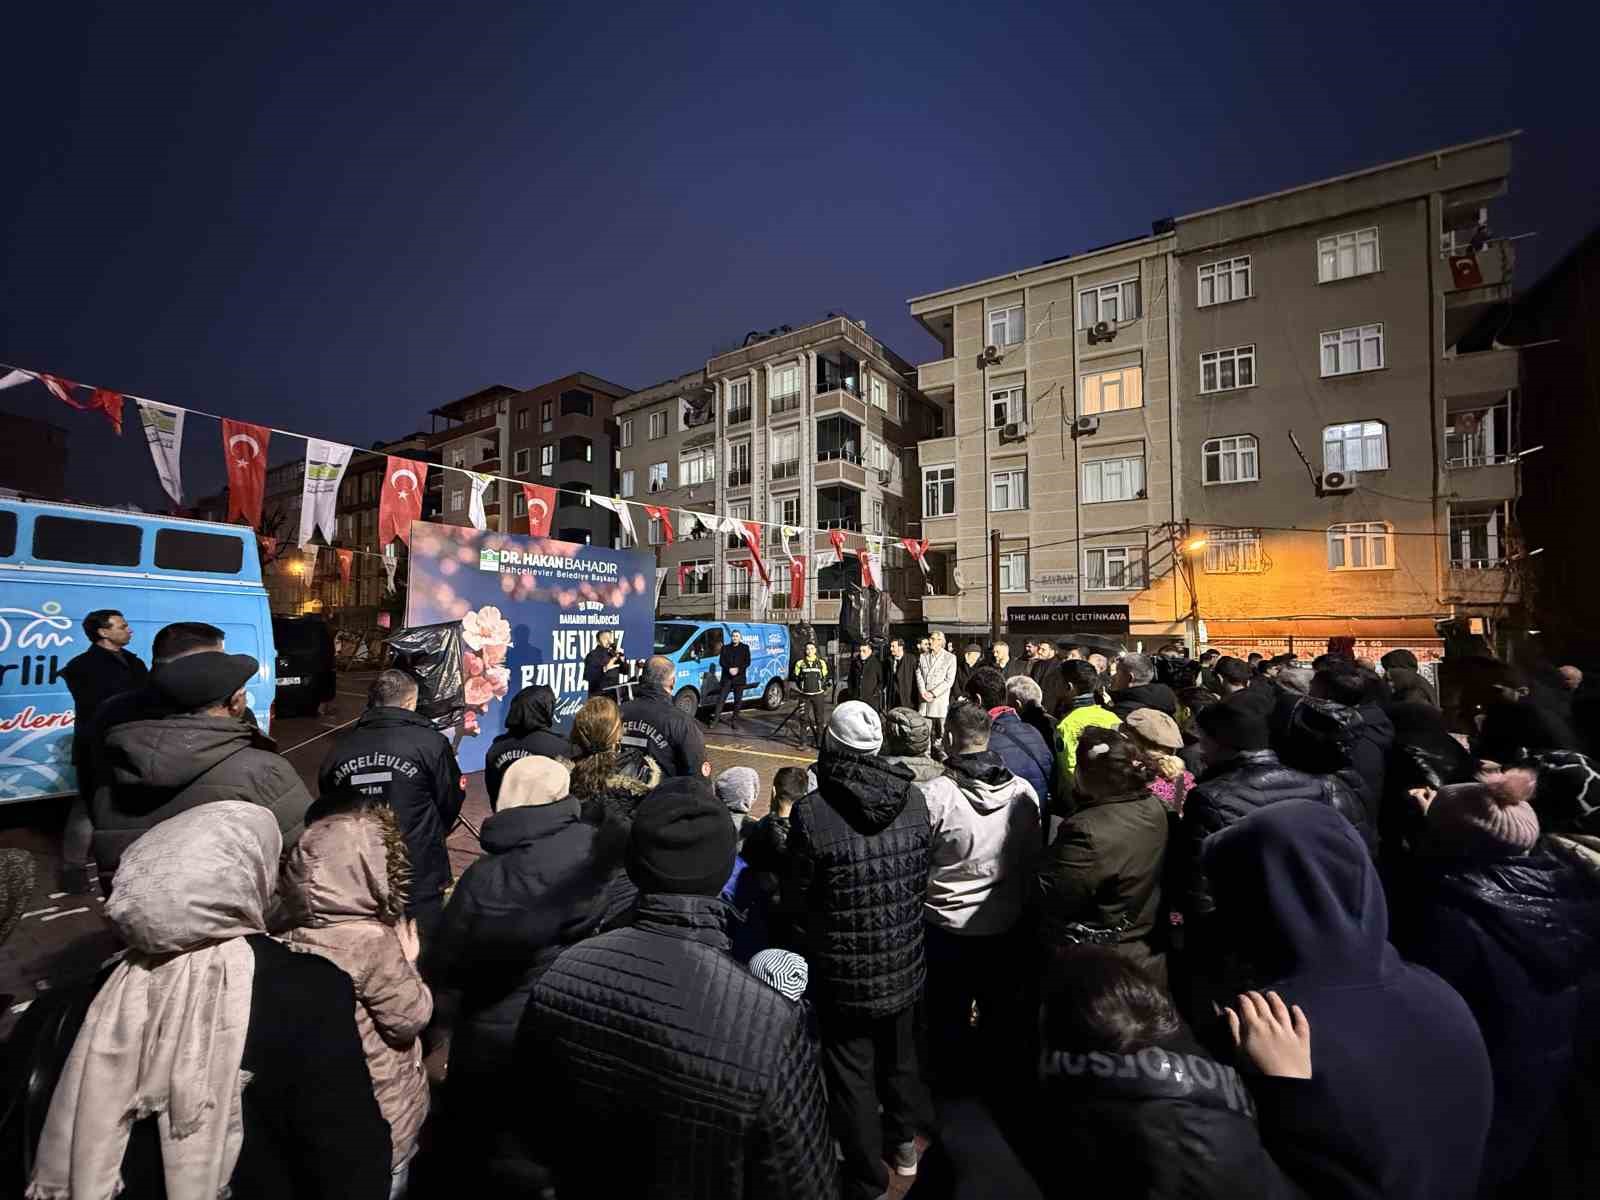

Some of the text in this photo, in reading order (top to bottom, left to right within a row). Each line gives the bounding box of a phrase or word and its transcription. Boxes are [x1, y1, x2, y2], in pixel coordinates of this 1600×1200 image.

[500, 550, 618, 575] DR. HAKAN BAHADIR
[1009, 613, 1026, 622] THE
[1028, 613, 1049, 621] HAIR
[1051, 613, 1069, 621] CUT
